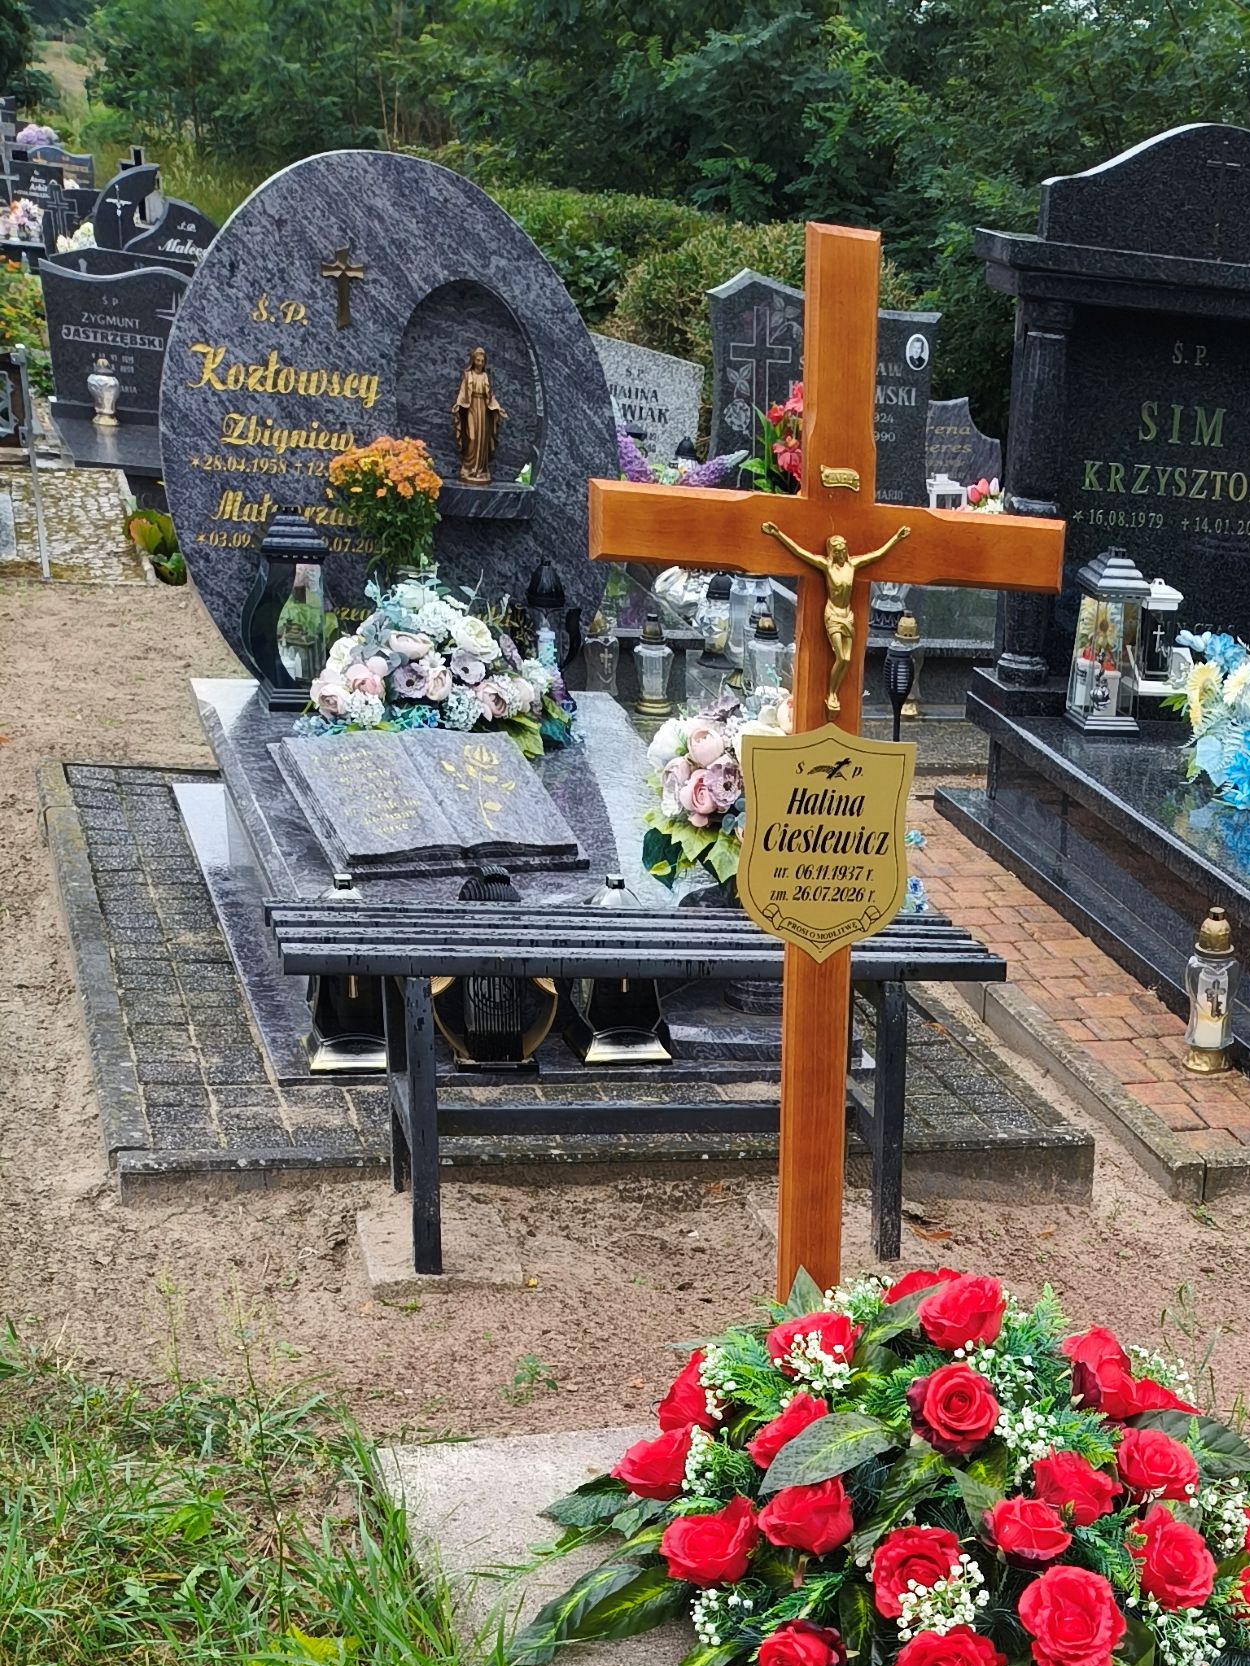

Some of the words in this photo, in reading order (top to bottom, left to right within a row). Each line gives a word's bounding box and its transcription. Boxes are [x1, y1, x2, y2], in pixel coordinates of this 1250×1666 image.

[81, 312, 140, 329] ZYGMUNT
[61, 324, 164, 351] JASTRZĘBSKI
[187, 343, 382, 409] Kozłowscy
[875, 385, 917, 406] WSKI
[621, 403, 670, 424] WIAK
[874, 412, 894, 424] 924
[1138, 400, 1228, 448] SIM
[221, 413, 354, 454] Zbigniew
[873, 432, 896, 442] 990
[928, 425, 971, 435] rena
[203, 455, 287, 475] 28.04.1958
[1088, 508, 1164, 529] 16.08.1979
[786, 787, 866, 818] Halina
[763, 821, 890, 857] Cieślewicz
[773, 866, 789, 881] ur.
[795, 863, 864, 882] 06.11.1937
[770, 888, 789, 902] zm.
[792, 885, 864, 904] 26.07.2026
[786, 920, 810, 936] PROSI
[809, 931, 816, 939] O
[816, 921, 858, 940] MODLITWĘ
